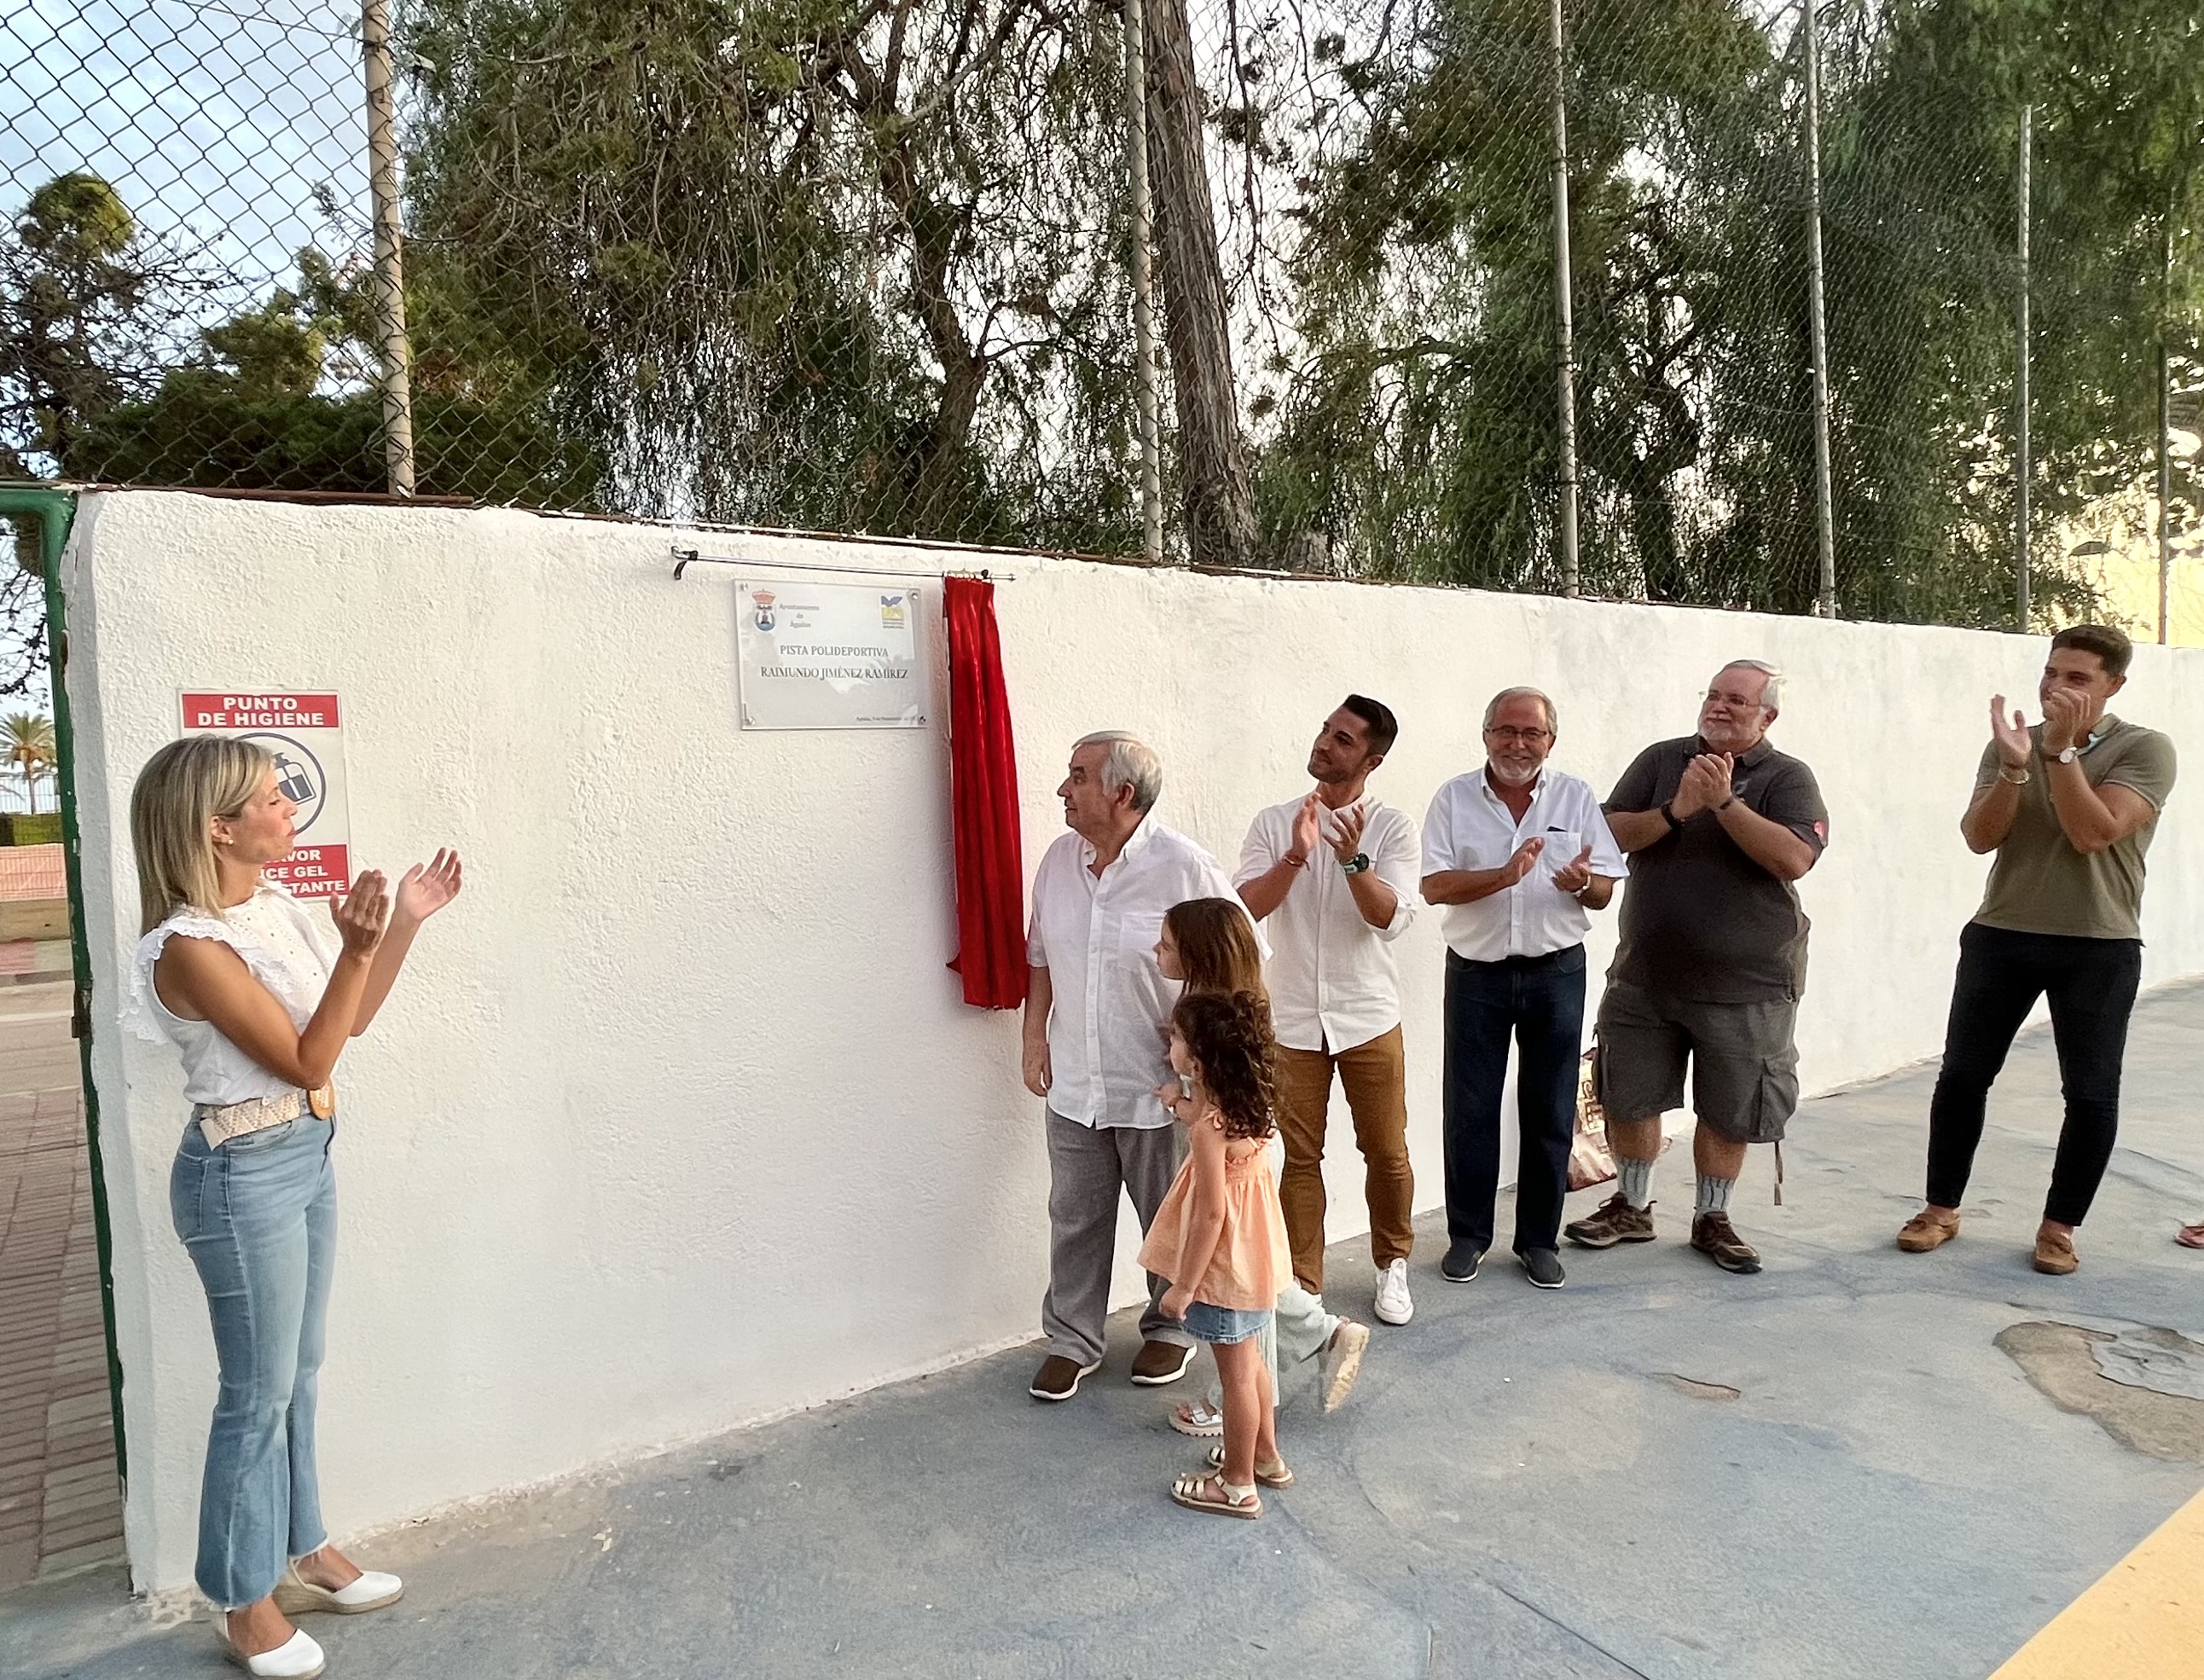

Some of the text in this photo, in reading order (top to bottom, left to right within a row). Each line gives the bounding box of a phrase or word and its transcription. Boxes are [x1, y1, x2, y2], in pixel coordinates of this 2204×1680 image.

[780, 645, 889, 657] PISTA POLIDEPORTIVA
[761, 666, 819, 679] RAIMUNDO
[223, 697, 298, 710] PUNTO
[197, 712, 324, 727] DE HIGIENE
[293, 865, 328, 878] GEL
